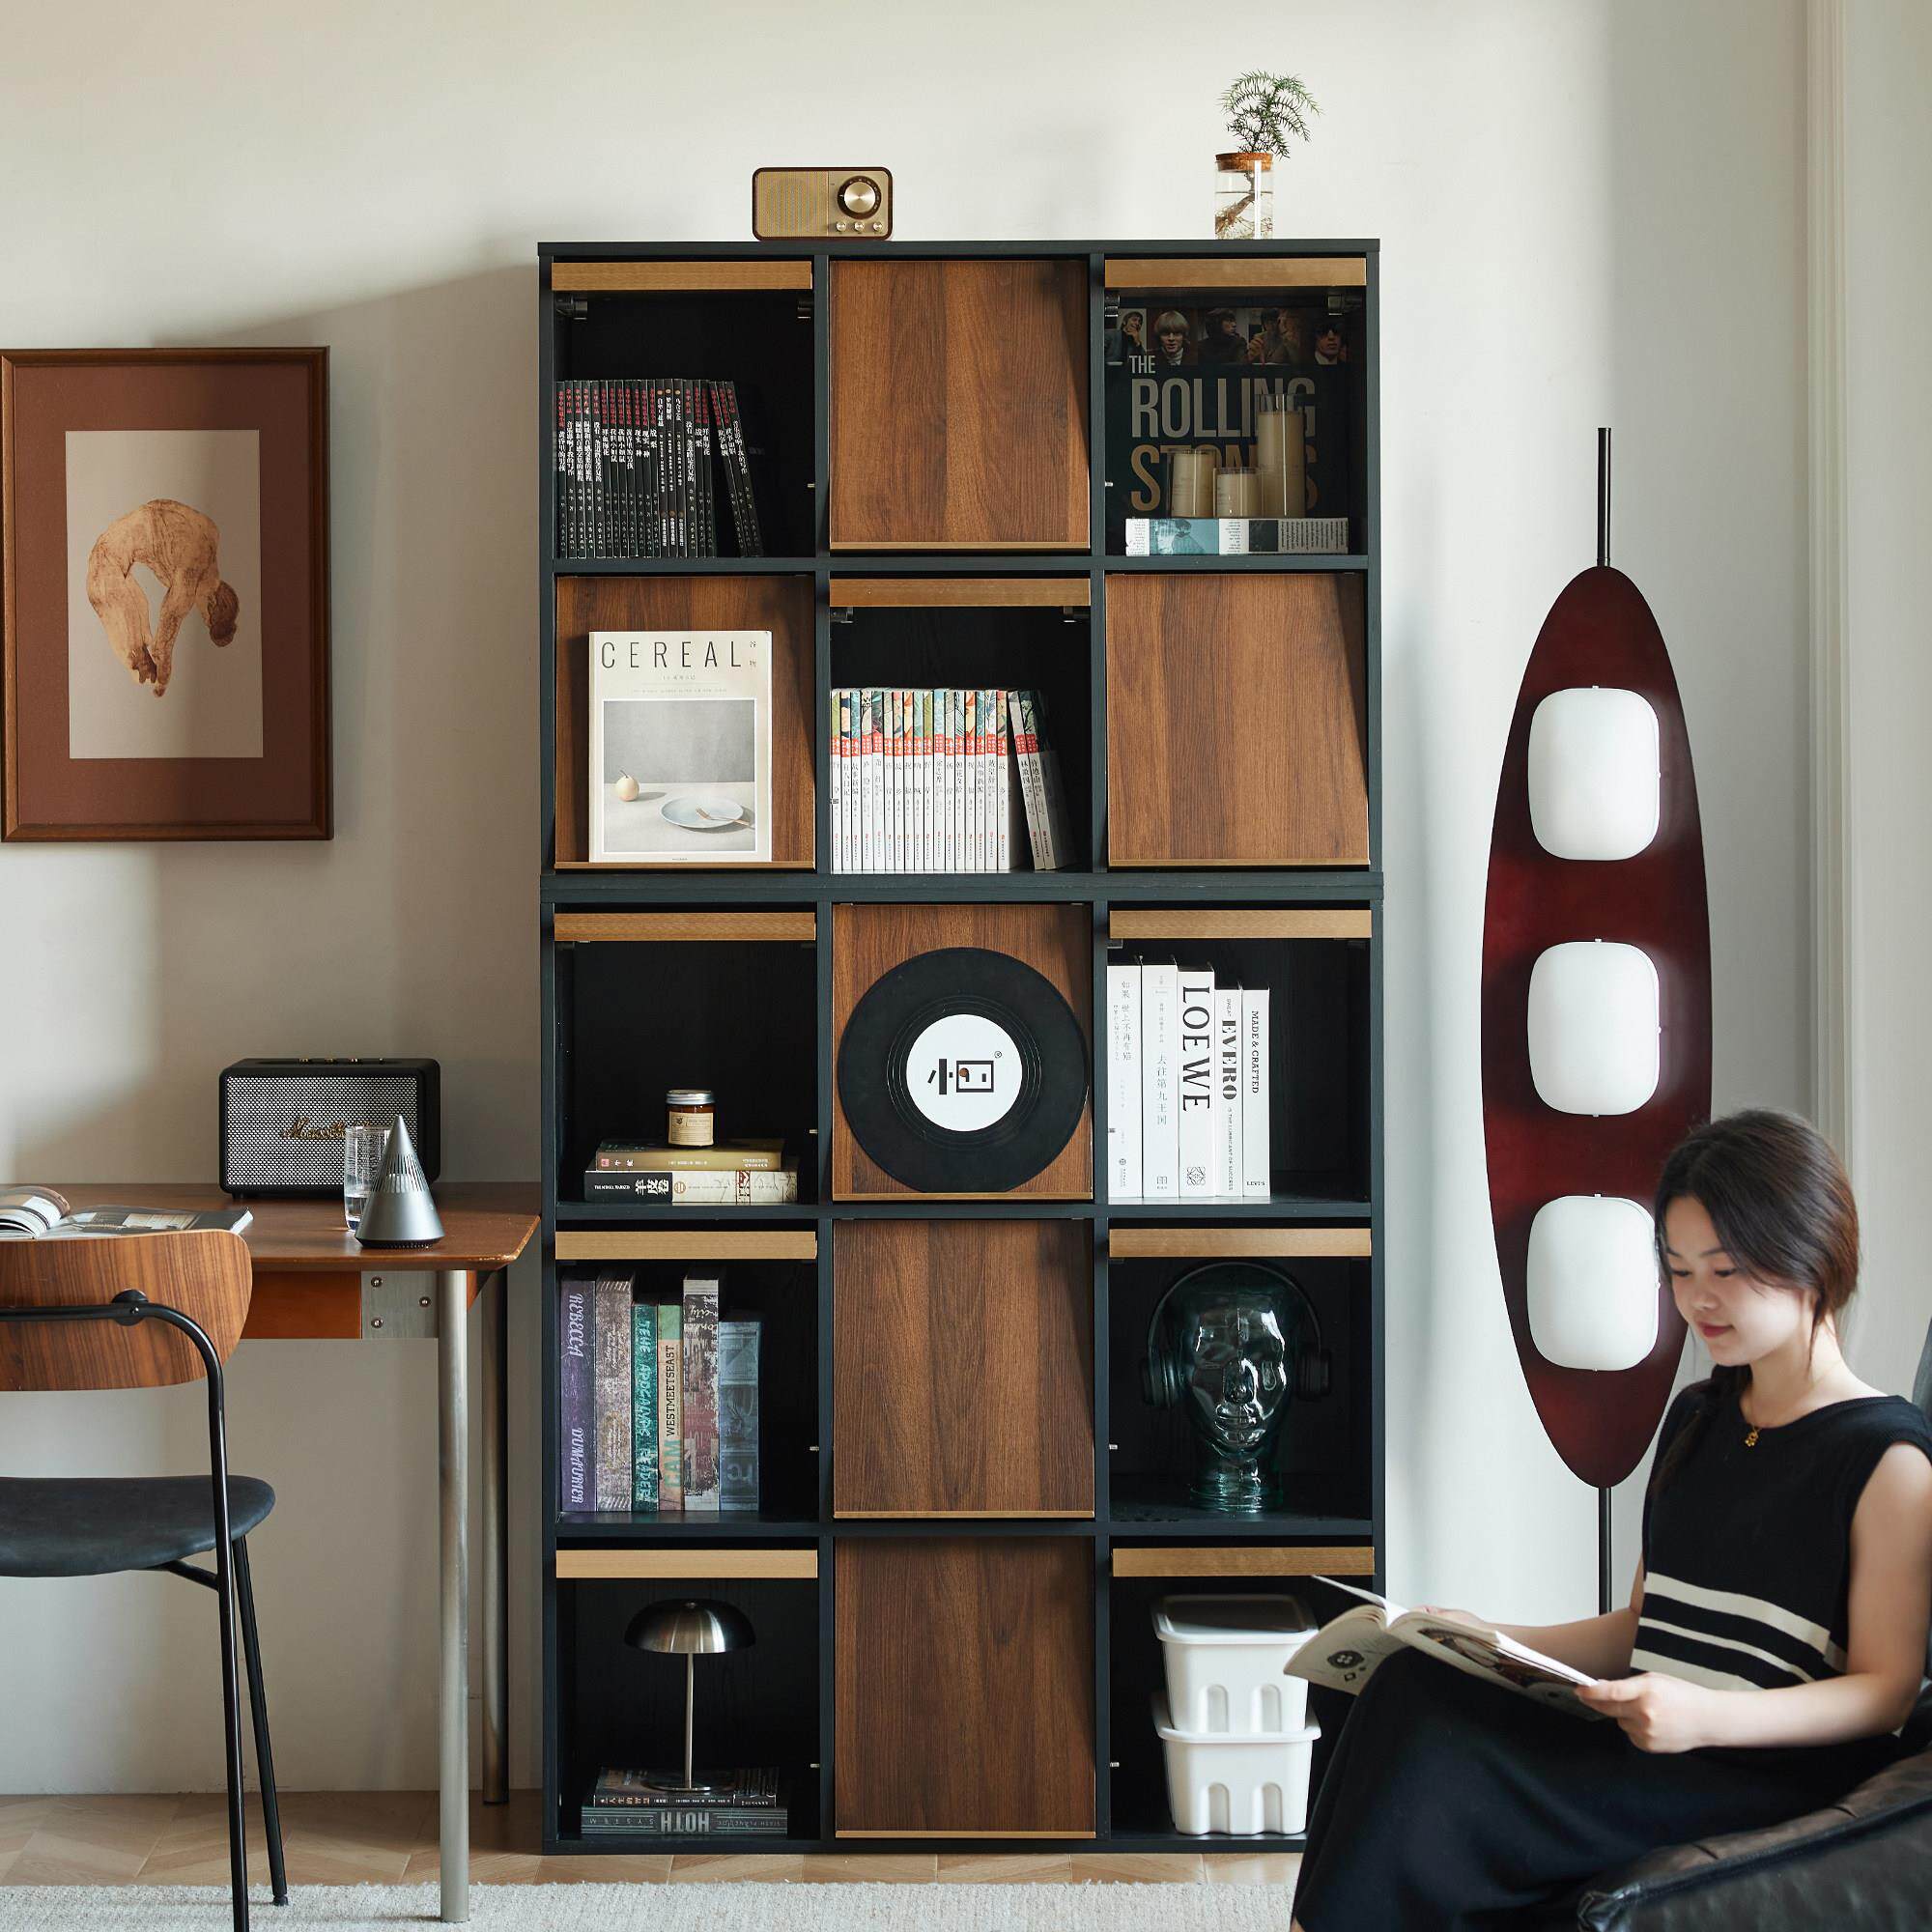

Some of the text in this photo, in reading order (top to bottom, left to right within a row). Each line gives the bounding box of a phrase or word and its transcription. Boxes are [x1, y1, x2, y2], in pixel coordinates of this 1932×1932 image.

[1129, 355, 1155, 374] THE
[1131, 377, 1316, 438] ROLLING
[601, 640, 742, 668] CEREAL
[1182, 986, 1209, 1111] LOEWE
[1222, 1020, 1237, 1100] EVERO
[1157, 1052, 1168, 1125] 去往第九王国
[635, 1179, 669, 1196] 羊皮卷
[569, 1293, 584, 1357] REBECCA
[667, 1346, 675, 1436] WESTMEETSEAST
[661, 1812, 710, 1833] HOTH
